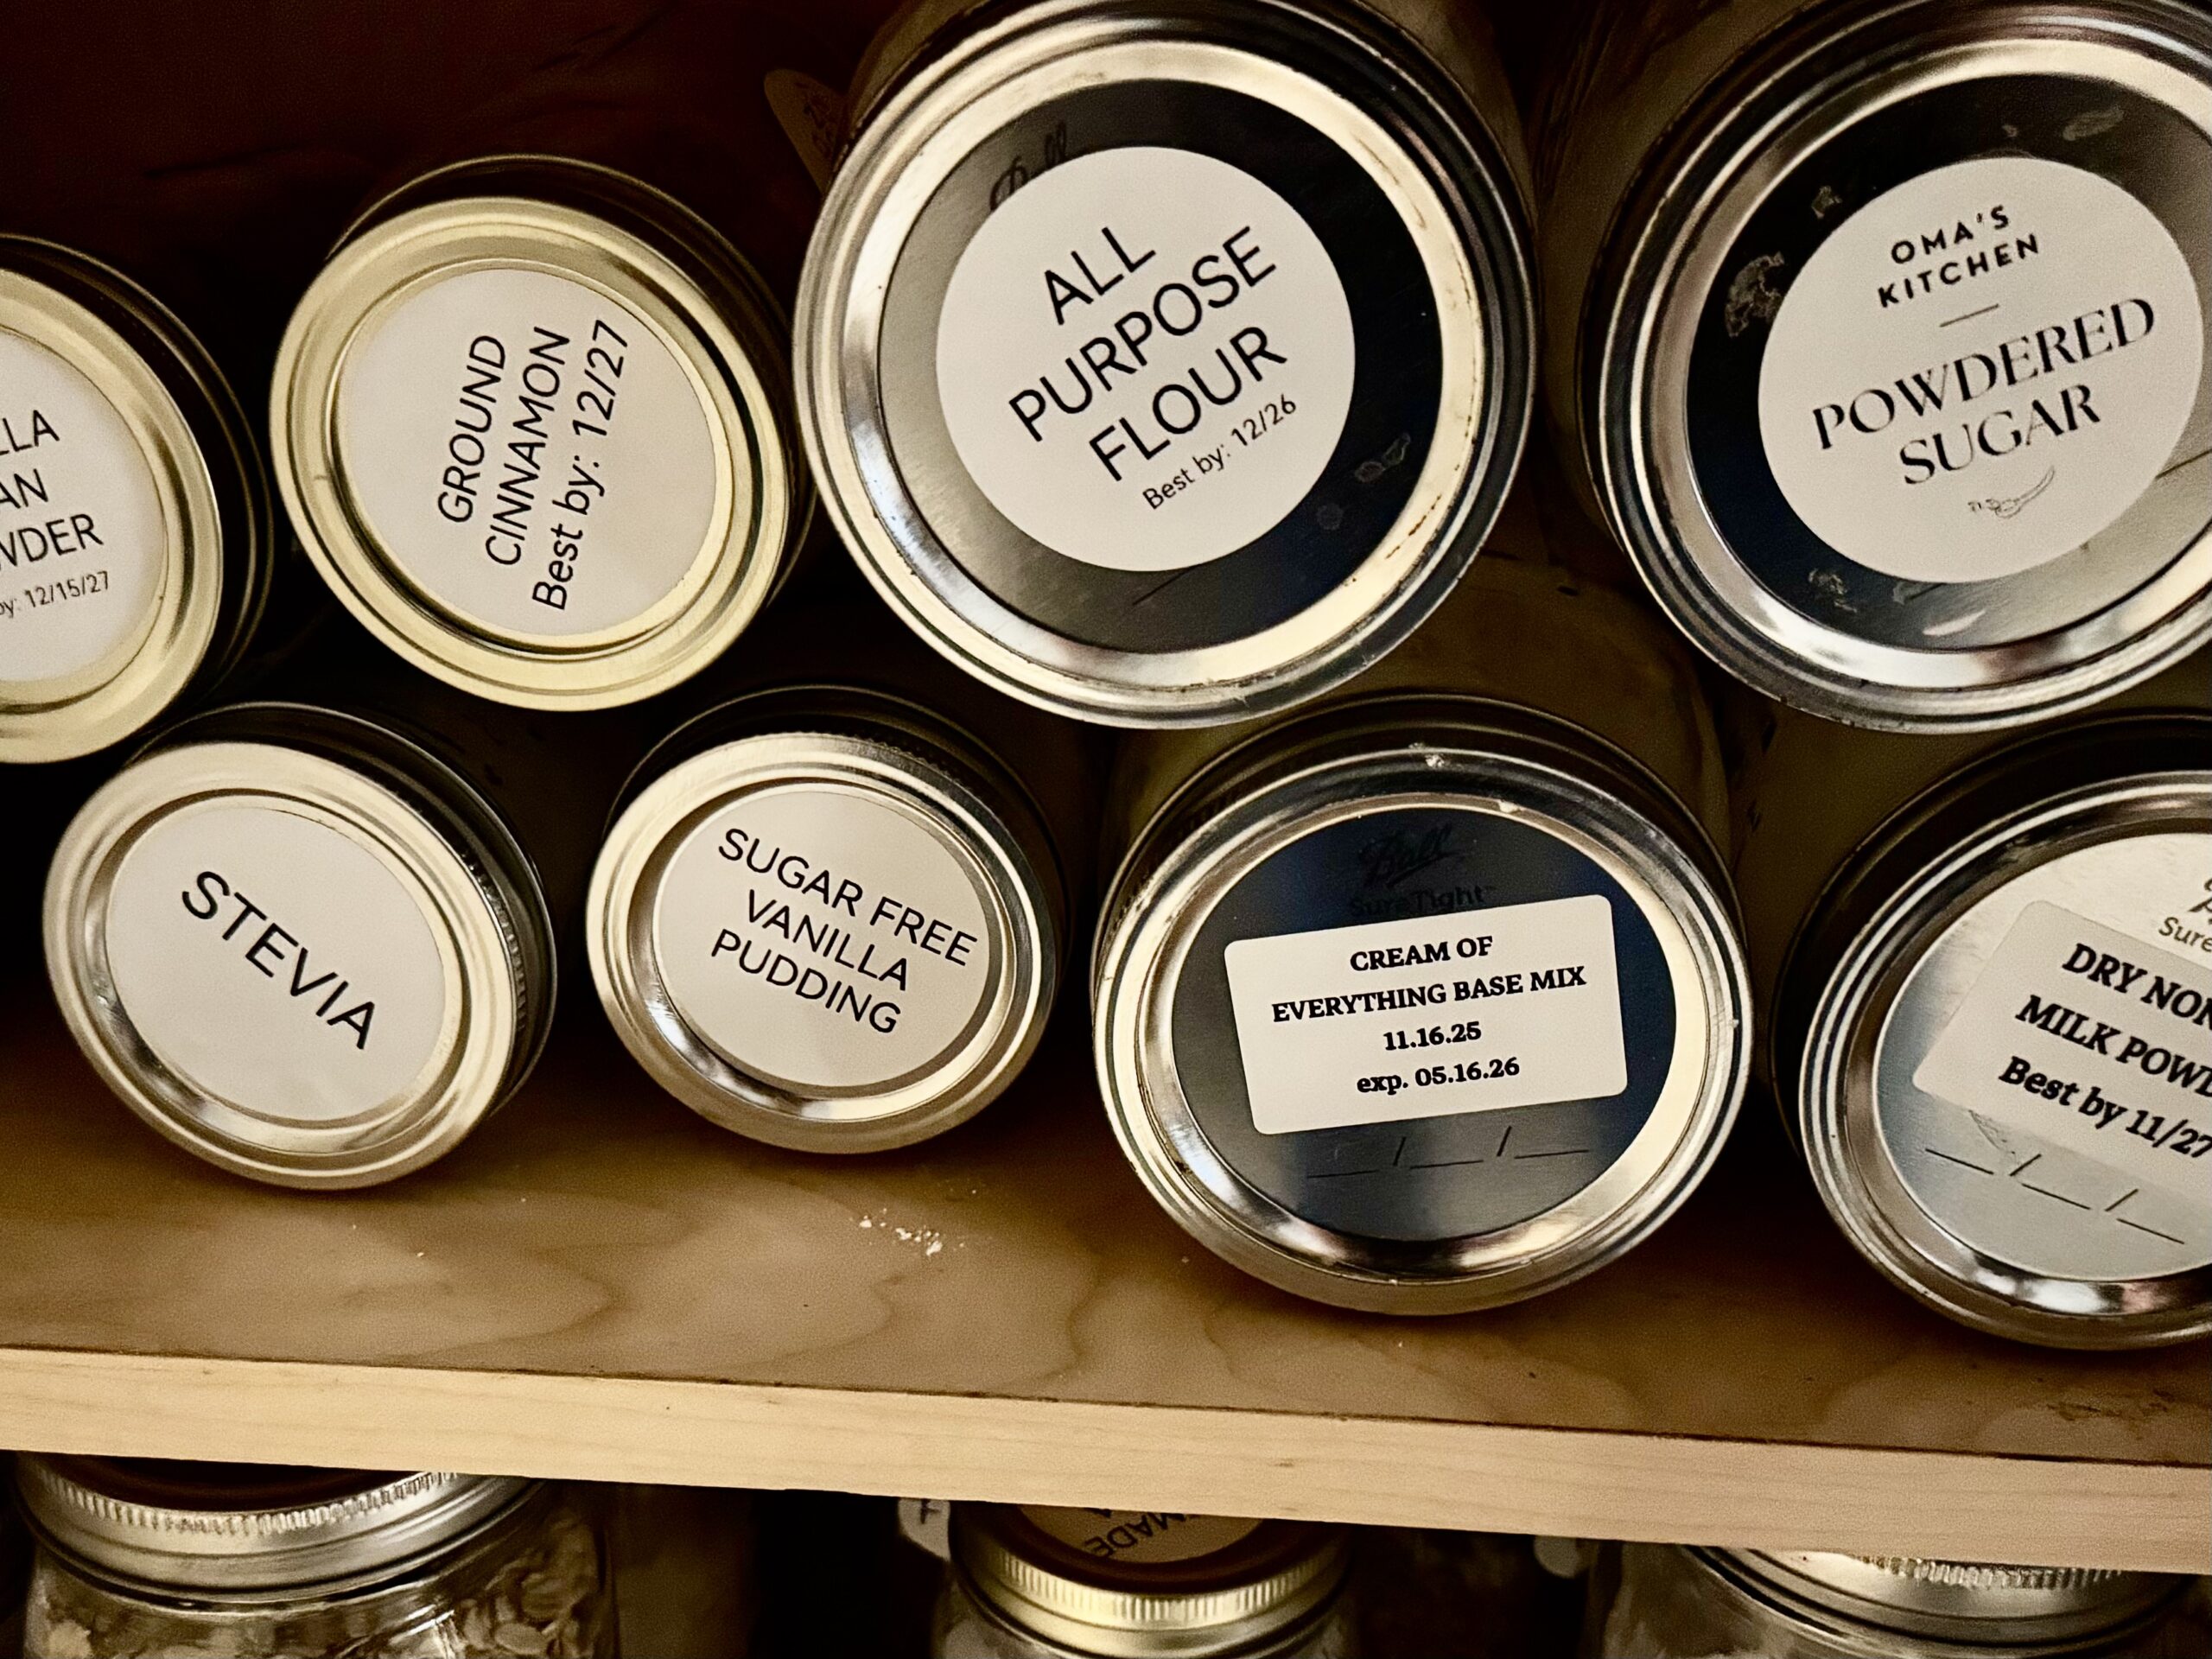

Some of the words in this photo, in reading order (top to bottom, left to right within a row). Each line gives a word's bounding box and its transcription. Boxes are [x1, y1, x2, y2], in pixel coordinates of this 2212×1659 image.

[1043, 227, 1156, 325] ALL
[1878, 234, 2039, 308] KITCHEN
[1891, 204, 2010, 264] OMA'S
[572, 320, 628, 435] 12/27
[1008, 226, 1277, 442] PURPOSE
[1812, 297, 2155, 450] POWDERED
[437, 335, 506, 523] GROUND
[486, 326, 570, 565] CINNAMON
[1089, 326, 1287, 481] FLOUR
[1142, 467, 1193, 510] Best
[1192, 442, 1231, 486] by:
[1230, 393, 1297, 448] 12/26
[1900, 383, 2101, 485] SUGAR
[552, 454, 606, 516] by:
[24, 570, 109, 607] 12/15/27
[532, 523, 583, 610] Best
[718, 828, 863, 917] SUGAR
[869, 896, 978, 966] FREE
[748, 888, 907, 991] VANILLA
[181, 871, 376, 1050] STEVIA
[711, 928, 901, 1033] PUDDING
[1272, 983, 1446, 1022] EVERYTHING
[1453, 974, 1524, 1001] BASE
[1529, 965, 1587, 992] MIX
[1350, 941, 1451, 971] CREAM
[1456, 936, 1494, 959] OF
[2062, 943, 2148, 994] DRY
[1357, 1073, 1409, 1096] exp.
[1414, 1057, 1520, 1087] 05.16.26
[1383, 1020, 1482, 1052] 11.16.25
[2015, 995, 2121, 1056] MILK
[1999, 1057, 2080, 1106] Best
[2079, 1087, 2128, 1129] by
[2126, 1108, 2212, 1159] 11/27
